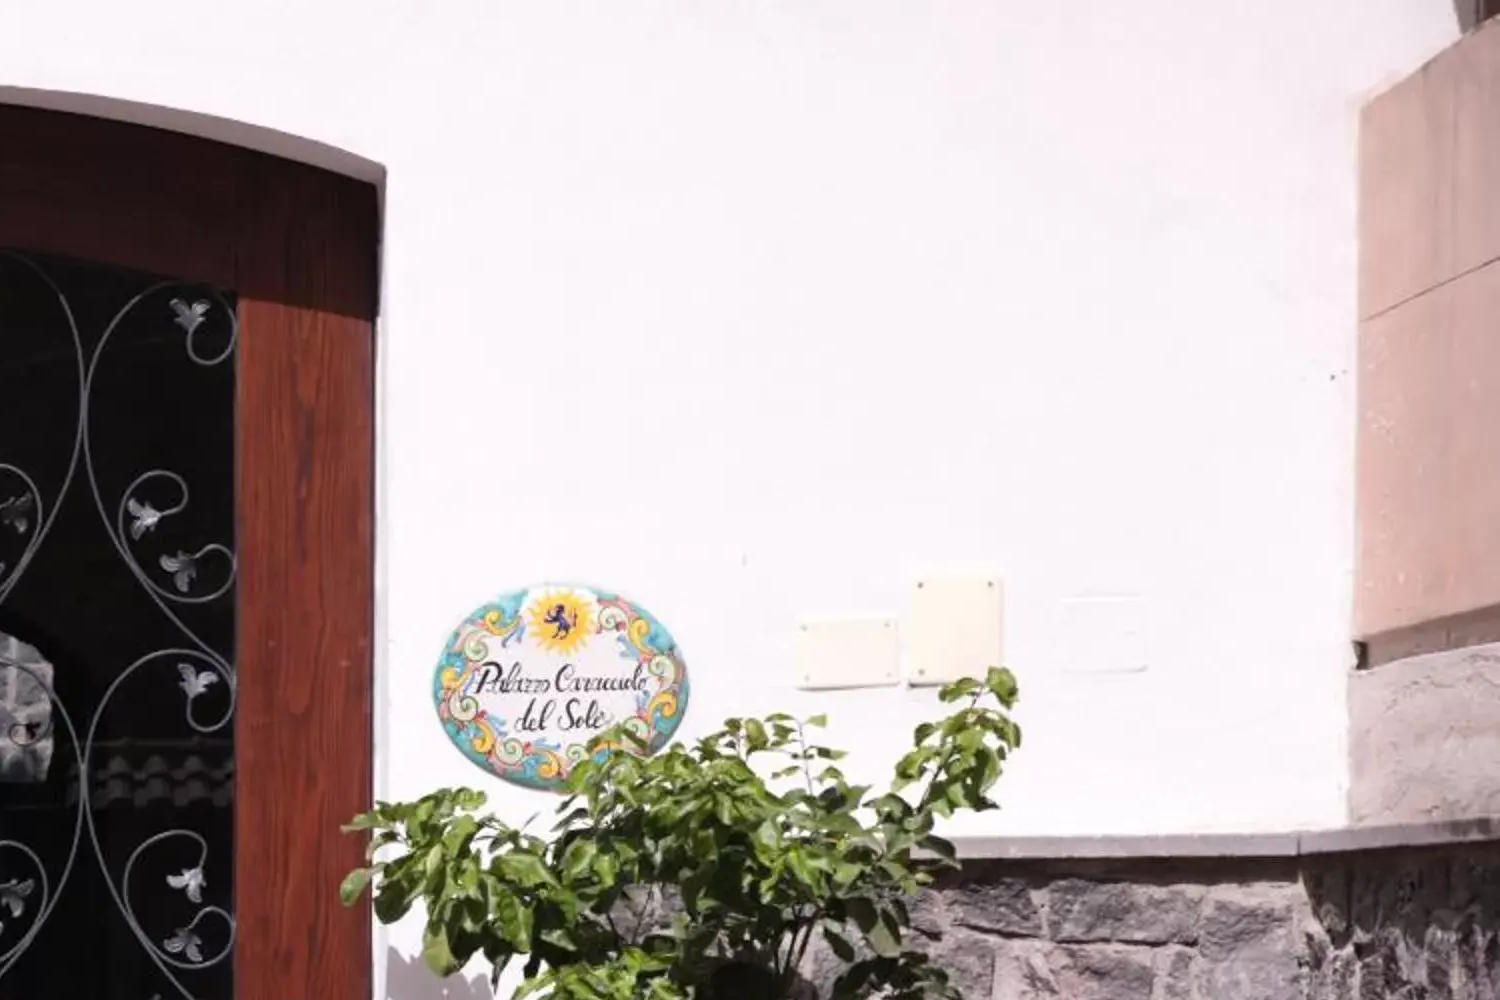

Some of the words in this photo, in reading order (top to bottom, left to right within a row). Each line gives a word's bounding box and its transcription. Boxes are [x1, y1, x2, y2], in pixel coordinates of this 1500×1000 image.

[475, 661, 551, 694] Palazzo
[514, 697, 556, 732] del
[558, 697, 607, 732] Sole
